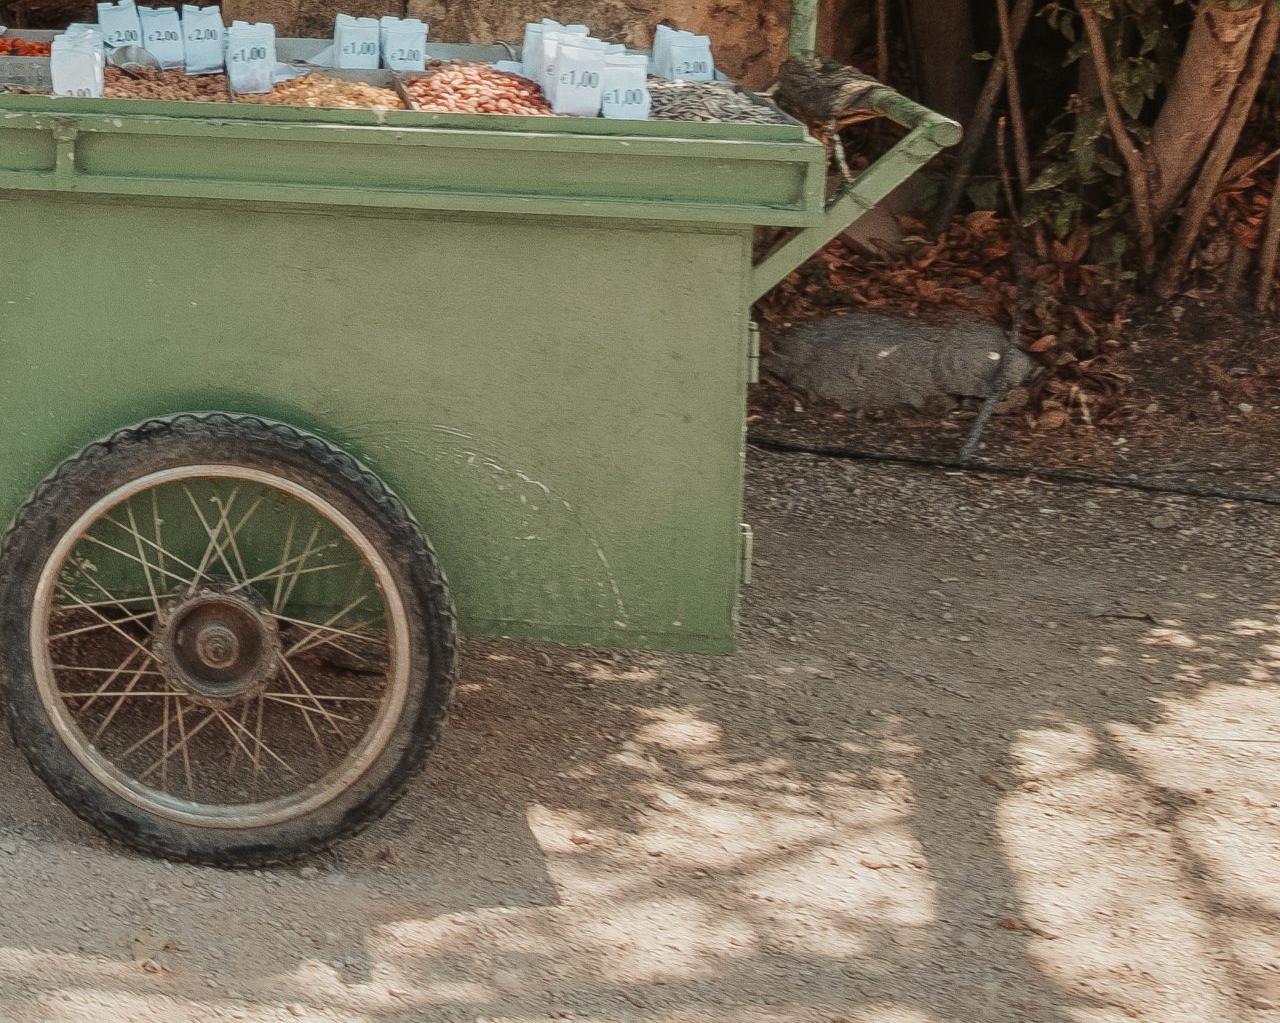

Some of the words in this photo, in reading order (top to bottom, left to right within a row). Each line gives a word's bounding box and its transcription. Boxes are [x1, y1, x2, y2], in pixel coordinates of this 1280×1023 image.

[108, 30, 138, 43] €2,00
[148, 30, 178, 43] €2,00
[188, 28, 218, 42] €2,00
[232, 47, 266, 63] €1,00
[343, 41, 376, 56] €1,00
[391, 48, 420, 62] €2,00
[676, 61, 708, 75] €2,00
[559, 70, 599, 89] €1,00
[603, 88, 644, 106] €1,00
